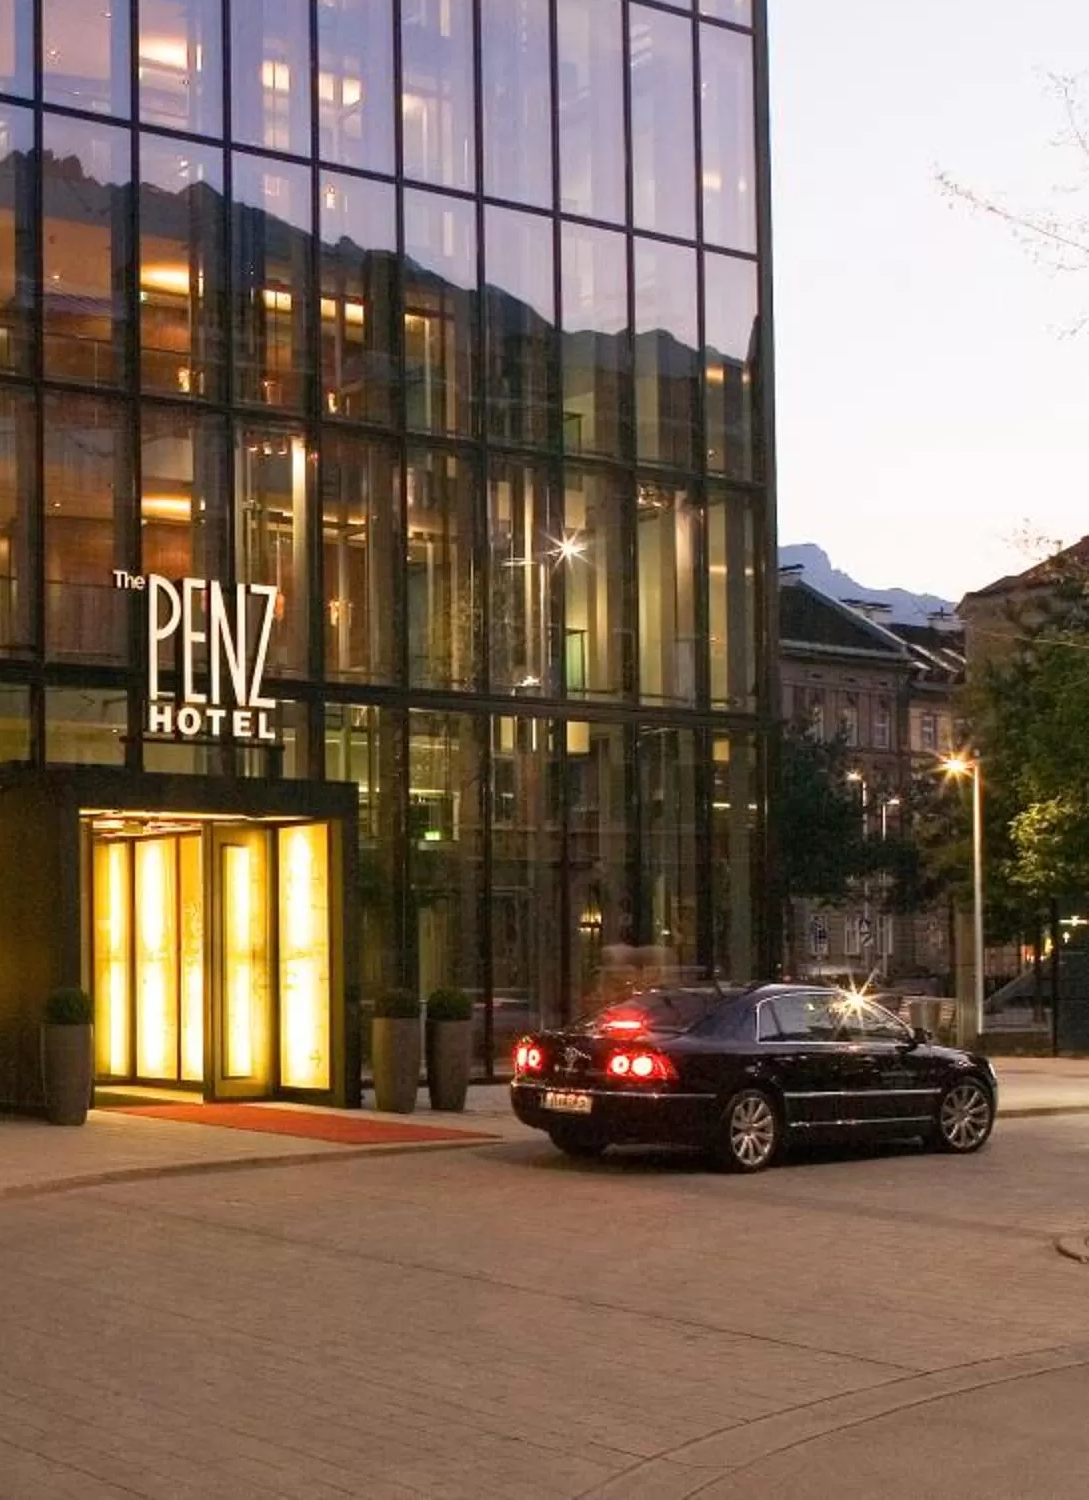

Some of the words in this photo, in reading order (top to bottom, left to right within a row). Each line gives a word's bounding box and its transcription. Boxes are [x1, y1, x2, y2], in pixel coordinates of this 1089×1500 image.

[113, 569, 146, 591] The
[148, 573, 278, 709] PENZ
[149, 704, 276, 739] HOTEL
